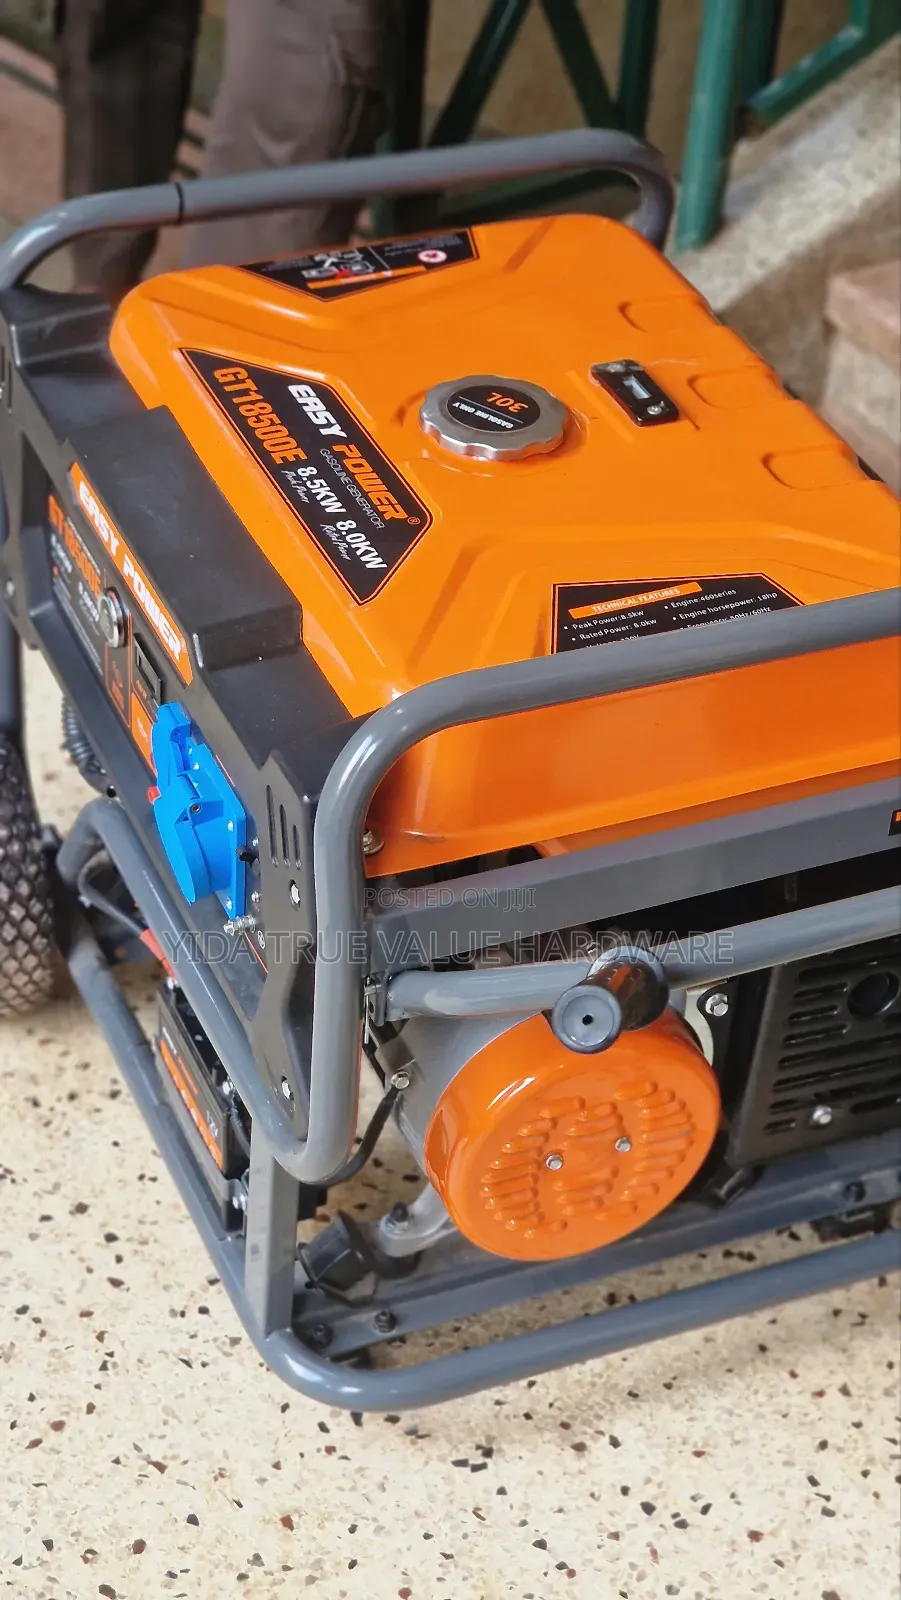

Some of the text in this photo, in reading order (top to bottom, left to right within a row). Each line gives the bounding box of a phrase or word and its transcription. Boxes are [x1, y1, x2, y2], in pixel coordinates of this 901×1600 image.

[213, 366, 307, 465] GT18500E
[288, 384, 348, 439] EASY
[452, 401, 514, 429] GASOLINE ONLY
[486, 392, 529, 413] 30L
[320, 448, 385, 530] GASOLINE GENERATOR
[79, 480, 120, 556] EASY
[297, 466, 388, 570] 8.5KW 8.0KW
[591, 588, 681, 613] TECHNICAL FEATURES
[679, 608, 708, 621] Engine
[756, 591, 778, 603] 18hp
[572, 618, 594, 630] Peak
[579, 629, 604, 641] Rated
[633, 618, 658, 629] 8.0kw
